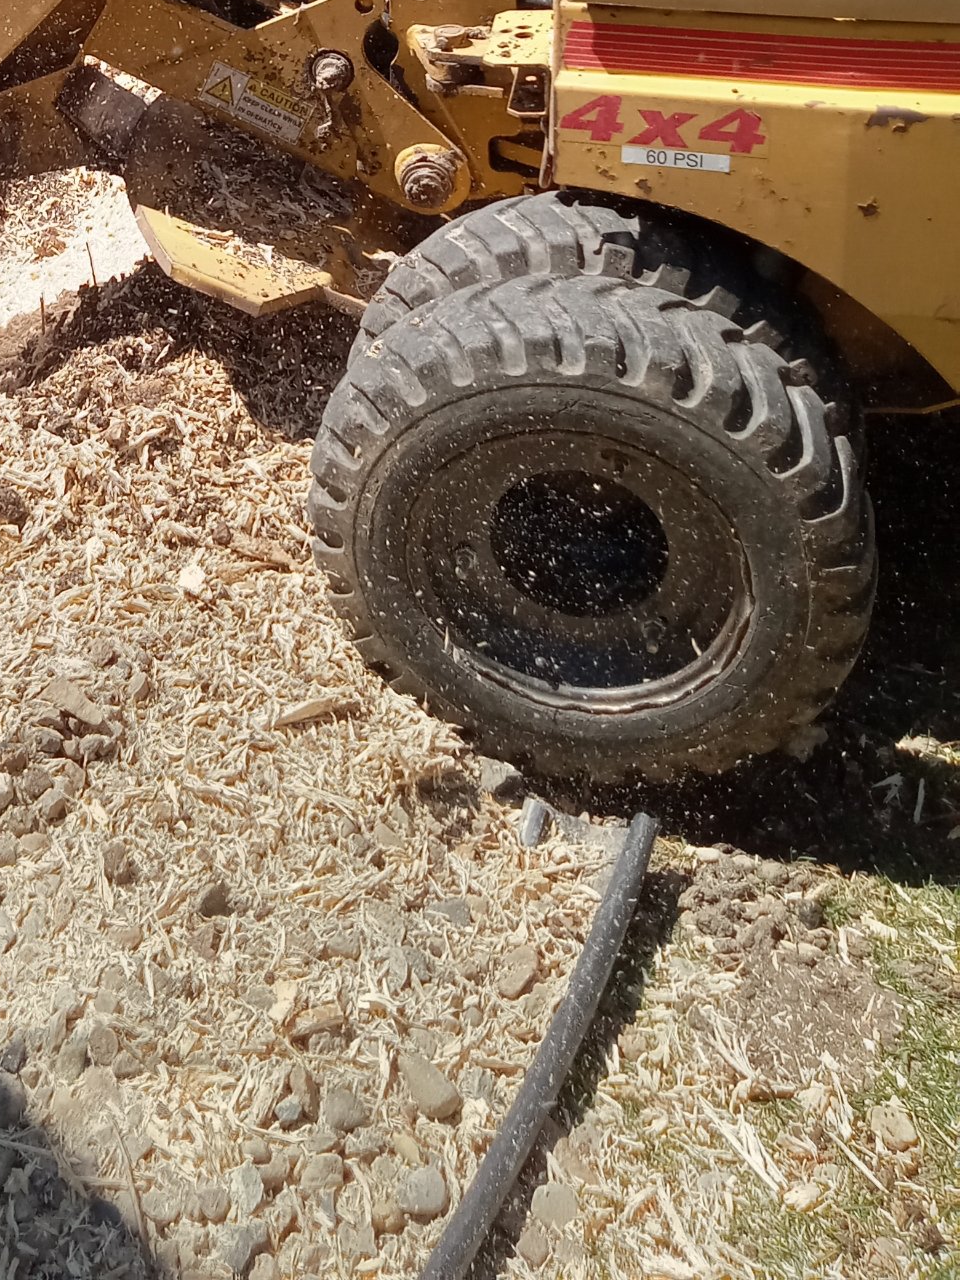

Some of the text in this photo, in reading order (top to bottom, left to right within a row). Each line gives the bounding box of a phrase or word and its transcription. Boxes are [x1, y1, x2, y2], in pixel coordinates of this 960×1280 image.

[260, 88, 309, 117] CAUTION
[646, 149, 704, 169] 60 PSI
